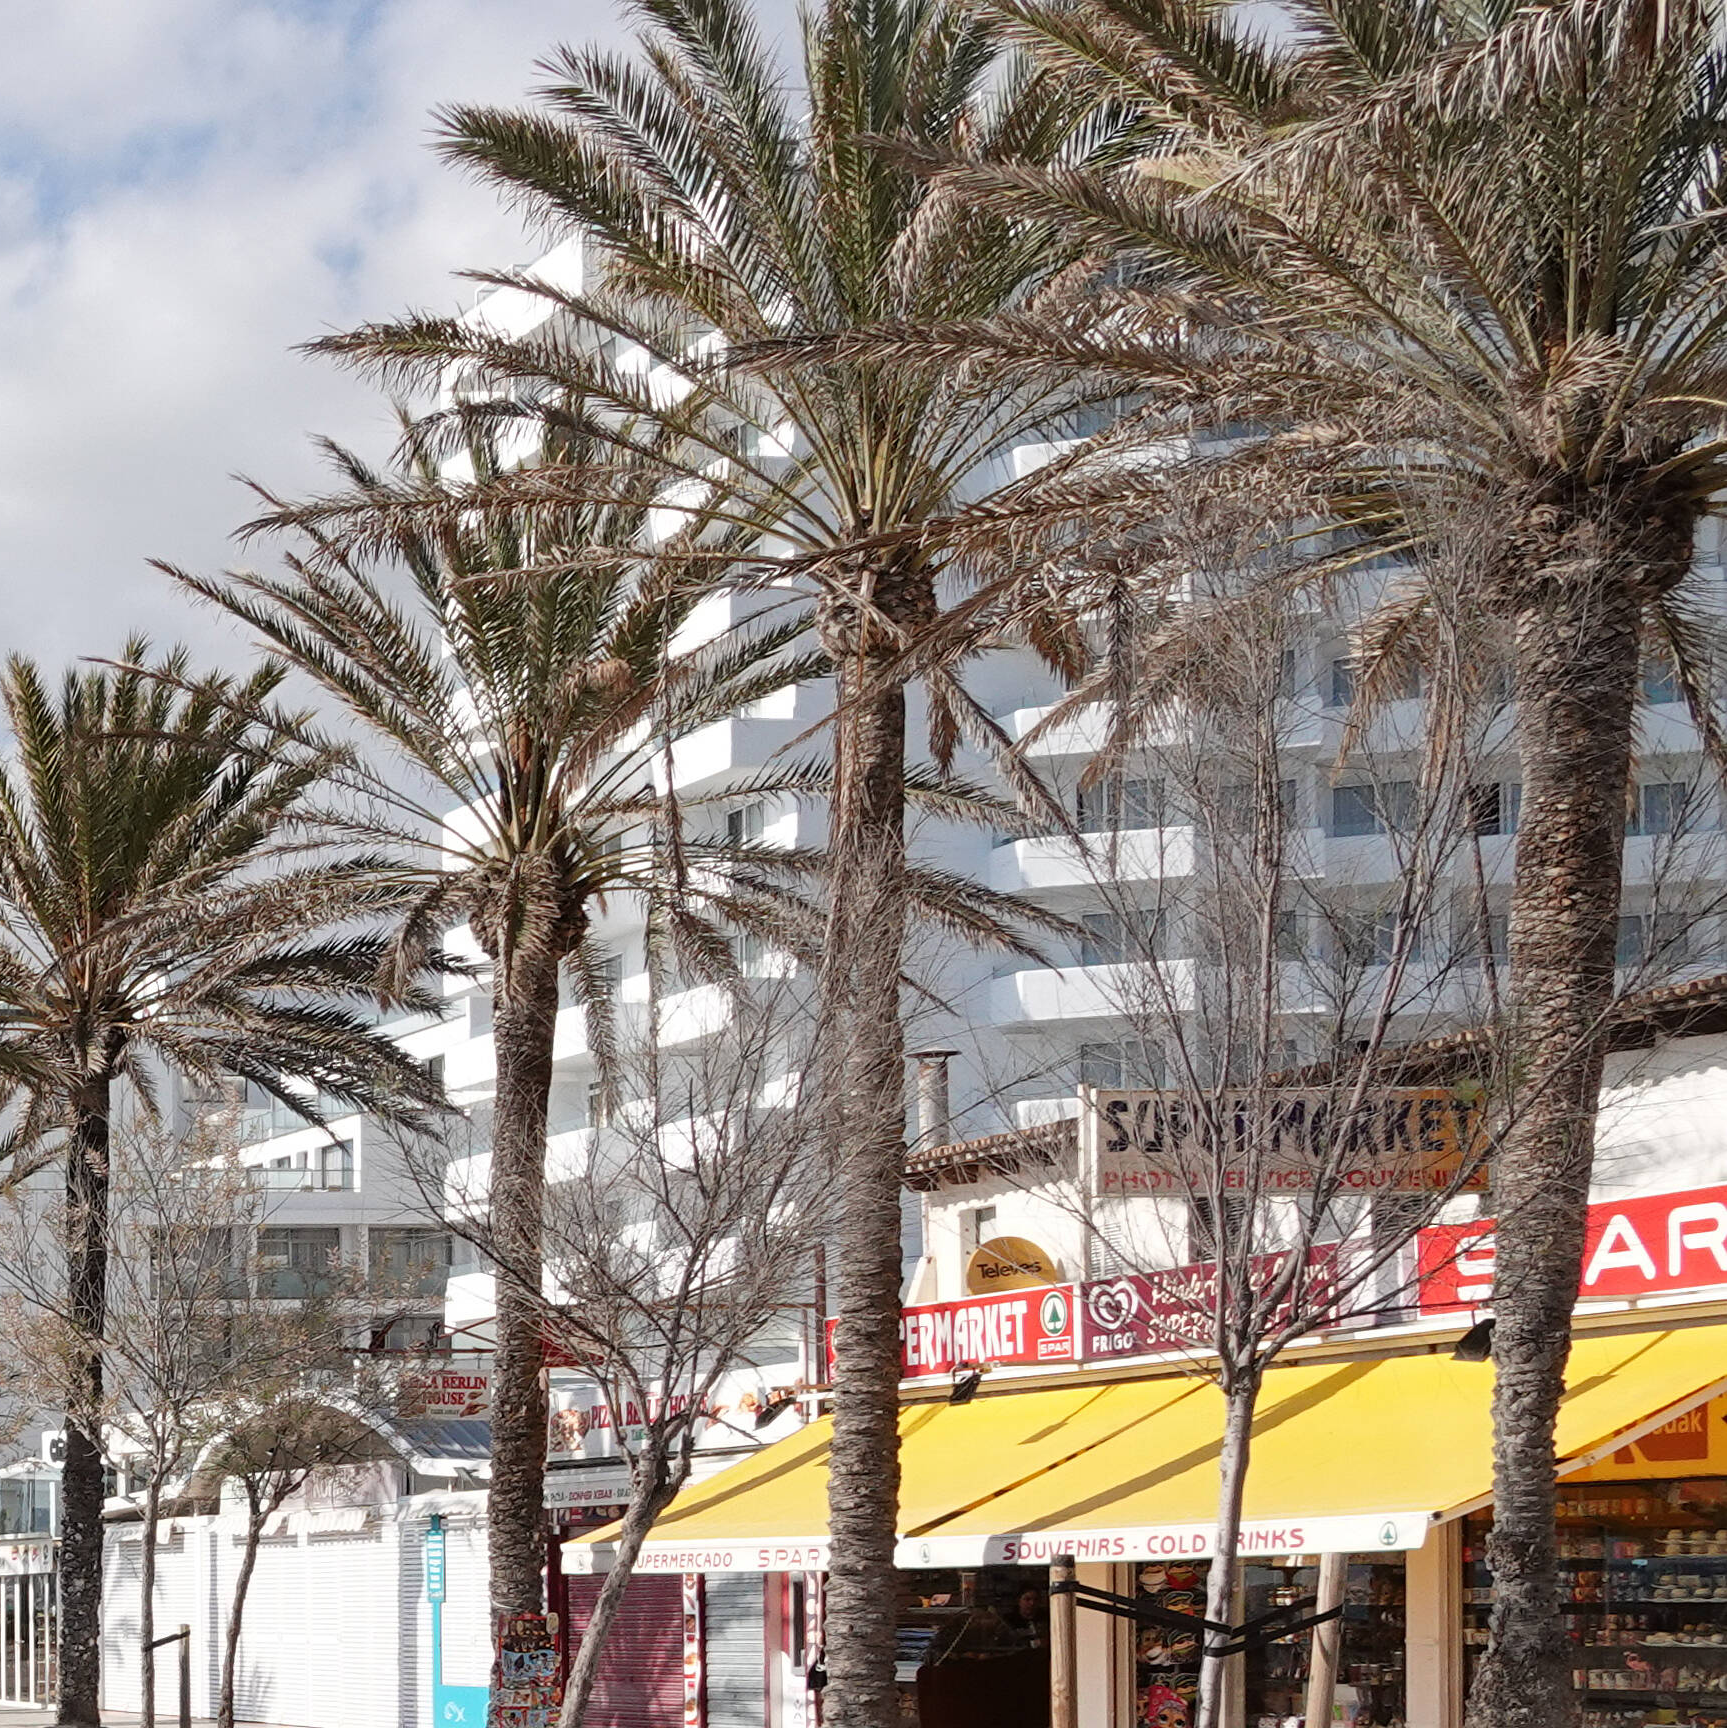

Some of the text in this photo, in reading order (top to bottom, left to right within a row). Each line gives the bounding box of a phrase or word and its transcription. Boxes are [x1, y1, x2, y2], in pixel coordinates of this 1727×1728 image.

[1455, 1201, 1727, 1301] SAR
[899, 1300, 1028, 1370] ERMARKET
[1092, 1331, 1134, 1353] FRIGO
[1039, 1340, 1071, 1354] SPAR
[442, 1376, 487, 1390] BERLIN
[422, 1391, 466, 1405] HOUSE
[591, 1403, 623, 1429] PIZA
[1002, 1538, 1125, 1561] SOUVENIRS
[1146, 1534, 1207, 1555] COLD
[1235, 1528, 1305, 1550] RINKS
[636, 1549, 821, 1569] UPERMERCADO SPAR
